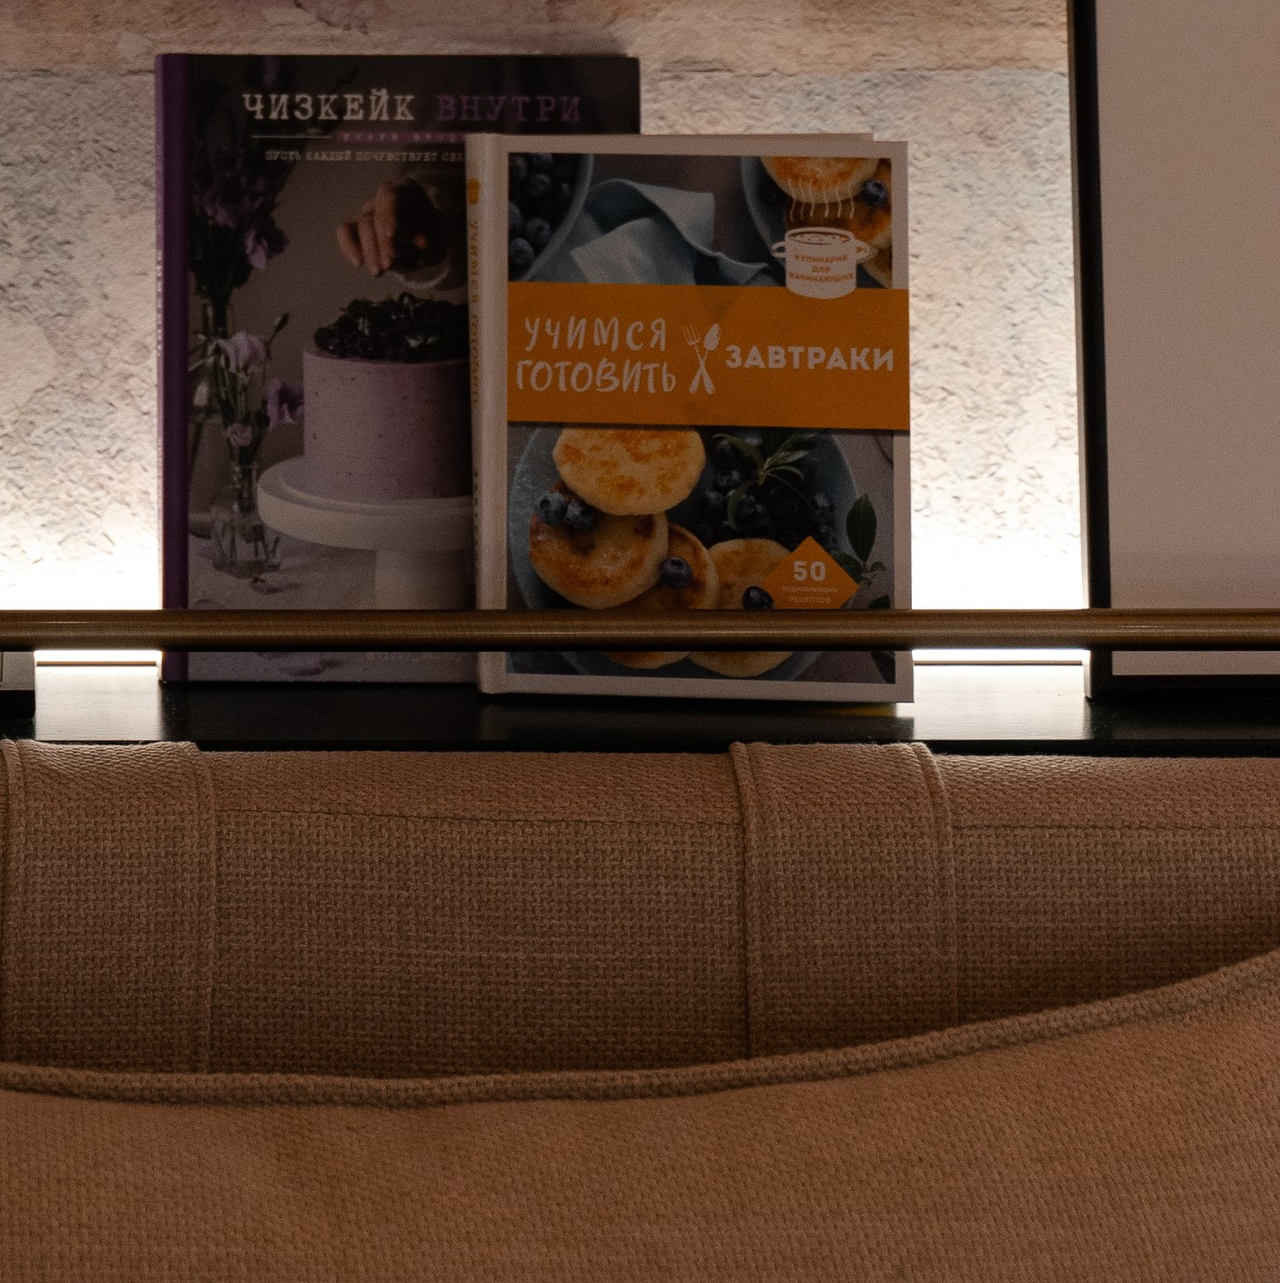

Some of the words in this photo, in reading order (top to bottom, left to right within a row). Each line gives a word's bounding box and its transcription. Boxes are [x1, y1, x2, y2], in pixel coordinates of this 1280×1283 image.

[242, 87, 416, 121] ЧИЗКЕЙК
[435, 94, 584, 123] ВНУТРИ
[264, 149, 302, 161] ПУСТЬ
[305, 148, 352, 161] КАЖДЫЙ
[355, 150, 438, 162] ПОЧУВСТВУЕТ
[524, 315, 667, 352] УЧИМСЯ
[725, 344, 894, 372] ЗАВТРАКИ
[515, 357, 677, 395] ГОТОВИТЬ
[793, 560, 826, 582] 50
